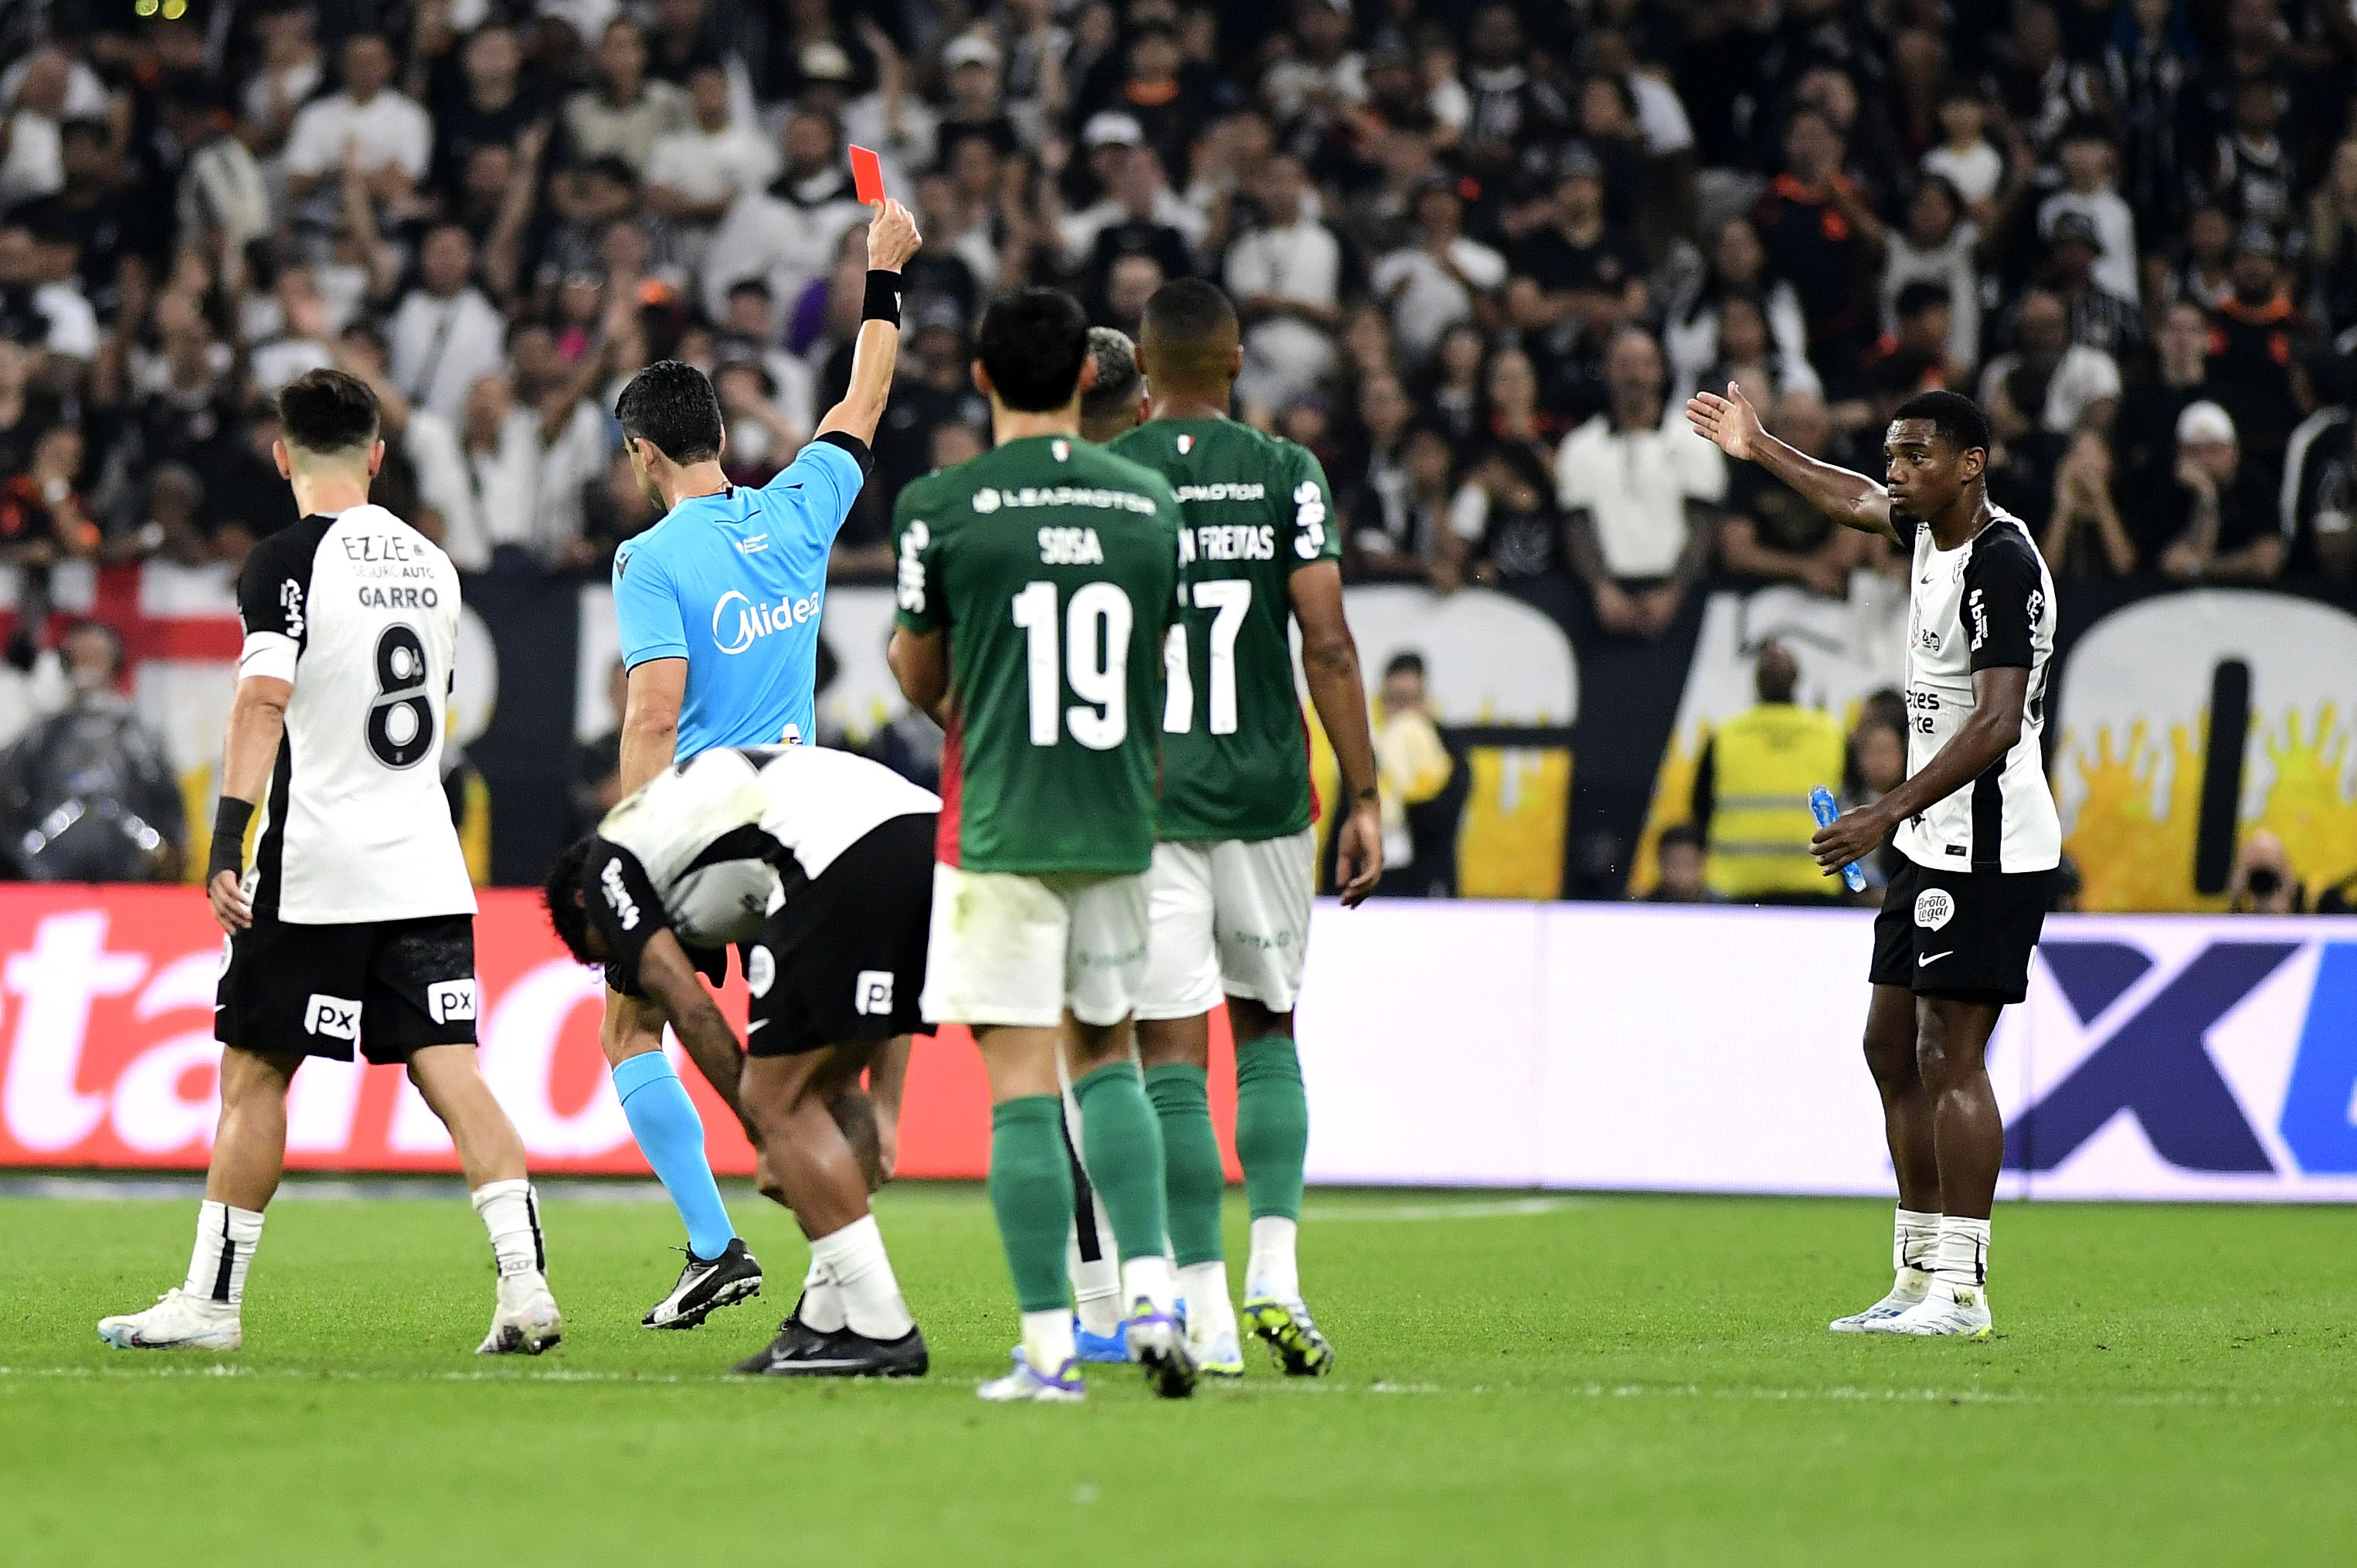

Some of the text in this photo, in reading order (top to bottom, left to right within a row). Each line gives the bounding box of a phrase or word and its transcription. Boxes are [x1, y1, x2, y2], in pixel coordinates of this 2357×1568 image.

[341, 535, 409, 562] EZZE
[1038, 526, 1104, 565] SOSA
[358, 585, 438, 609] GARRO
[712, 589, 820, 655] Midea
[1011, 581, 1134, 750] 19
[363, 622, 438, 772] 8
[1906, 690, 1940, 710] tes
[1917, 895, 1947, 910] Broto
[1918, 904, 1948, 922] Legal
[315, 1005, 355, 1033] px
[442, 992, 472, 1023] px
